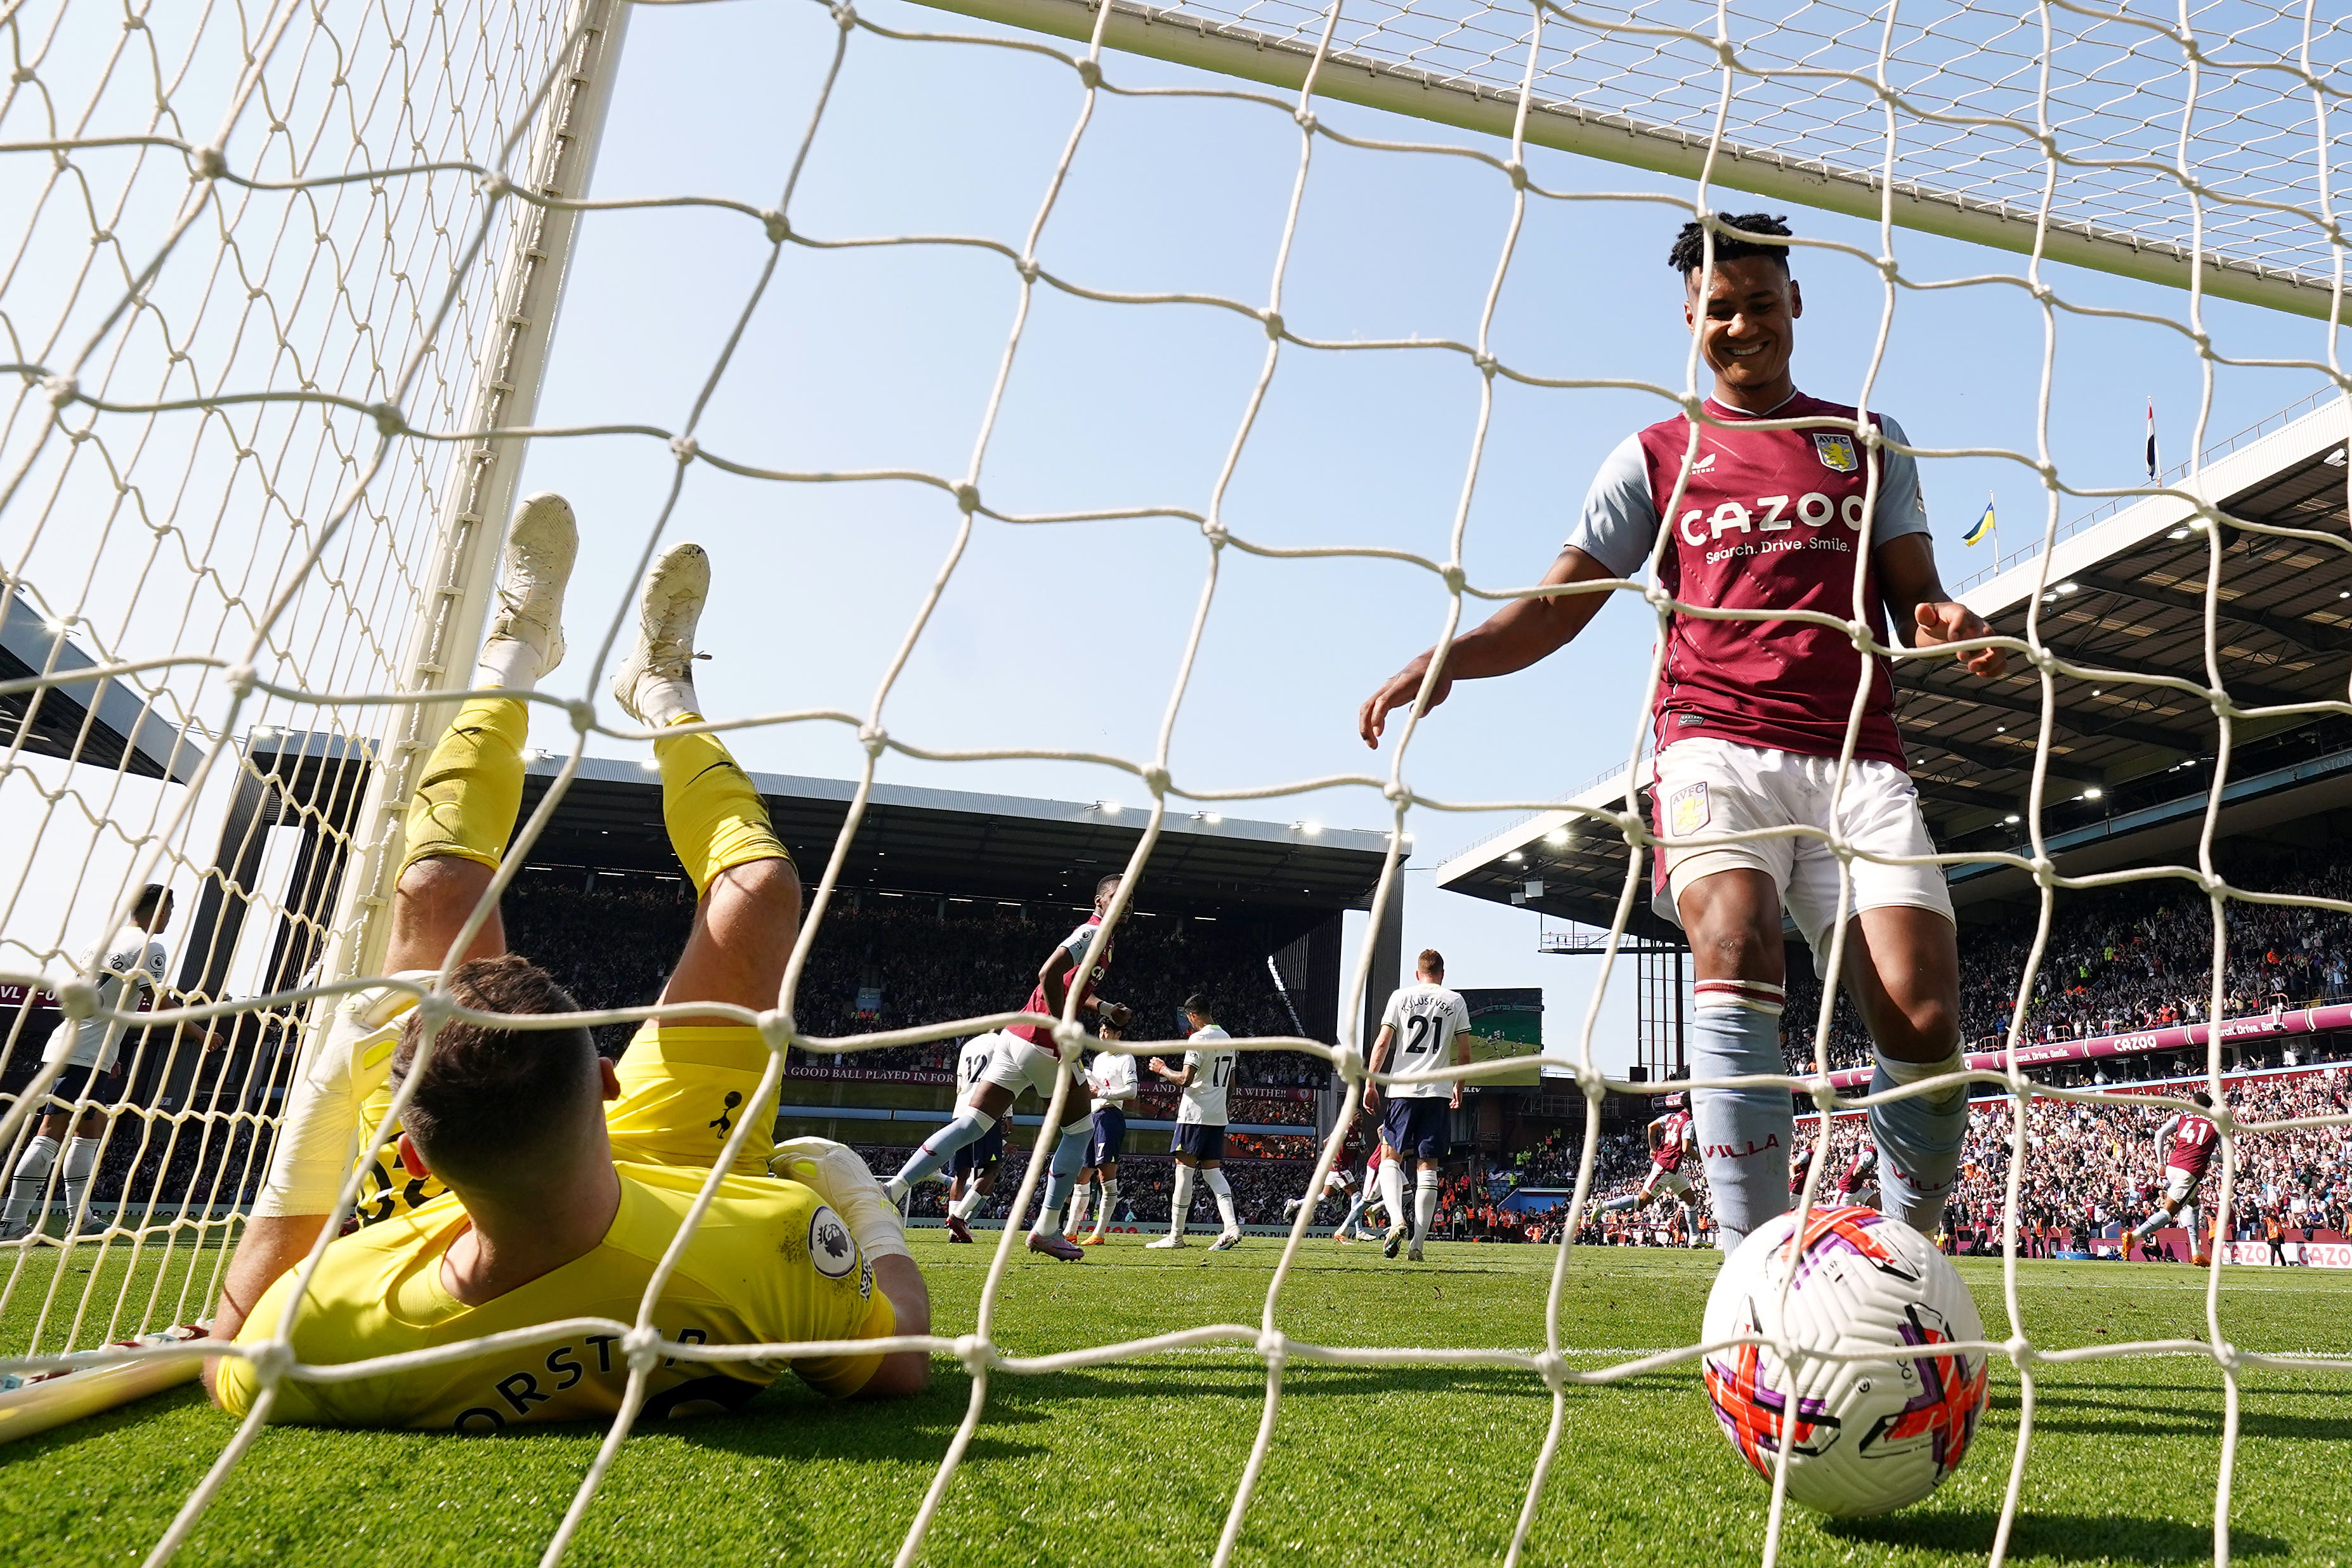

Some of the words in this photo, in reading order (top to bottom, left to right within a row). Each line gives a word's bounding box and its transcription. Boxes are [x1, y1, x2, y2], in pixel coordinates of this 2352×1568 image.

[1819, 436, 1848, 444] AVFC
[1681, 492, 1864, 547] CAZOO
[1706, 544, 1758, 565] Search.
[1761, 539, 1806, 554] Drive.
[1809, 537, 1851, 552] Smile.
[1673, 784, 1704, 805] AVFC
[1406, 1015, 1443, 1054] 21
[2235, 1022, 2261, 1035] Drive.
[2114, 1034, 2157, 1052] CAZOO
[2032, 1050, 2051, 1061] Drive.
[790, 1067, 829, 1077] GOOD
[832, 1069, 862, 1079] BALL
[865, 1070, 910, 1080] PLAYED
[913, 1072, 927, 1081] IN
[930, 1073, 954, 1083] FOR
[965, 1054, 988, 1083] 12
[1213, 1056, 1232, 1087] 17
[1152, 1084, 1176, 1093] AND
[1245, 1088, 1286, 1098] WITHE!!
[2179, 1120, 2208, 1146] 41
[1097, 1142, 1106, 1158] 7
[1702, 1134, 1779, 1158] VILLA
